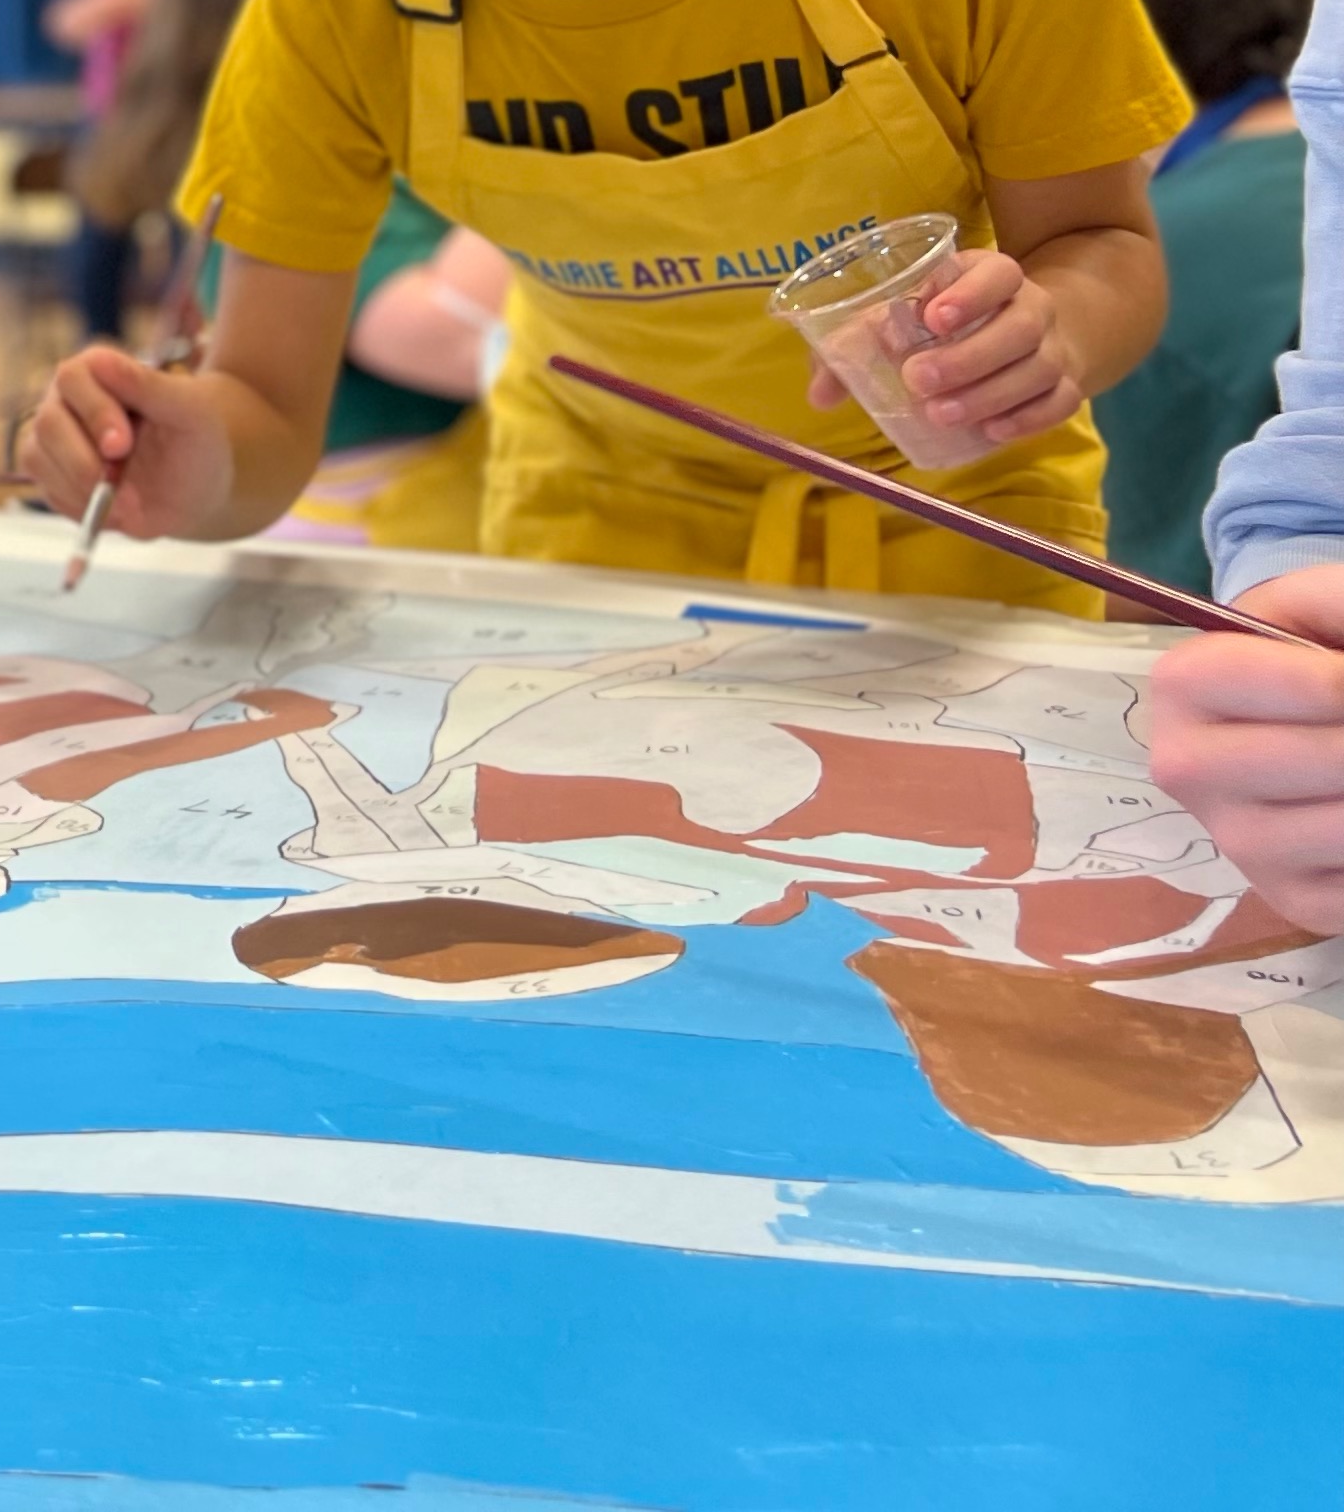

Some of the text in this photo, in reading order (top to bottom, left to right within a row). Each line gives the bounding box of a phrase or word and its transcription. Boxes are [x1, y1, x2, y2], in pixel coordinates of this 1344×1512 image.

[632, 256, 703, 289] ART
[645, 743, 690, 755] 101
[178, 798, 254, 821] 47
[1106, 795, 1153, 809] 101
[415, 885, 480, 896] 102
[921, 902, 984, 922] 101
[1246, 970, 1305, 987] 100
